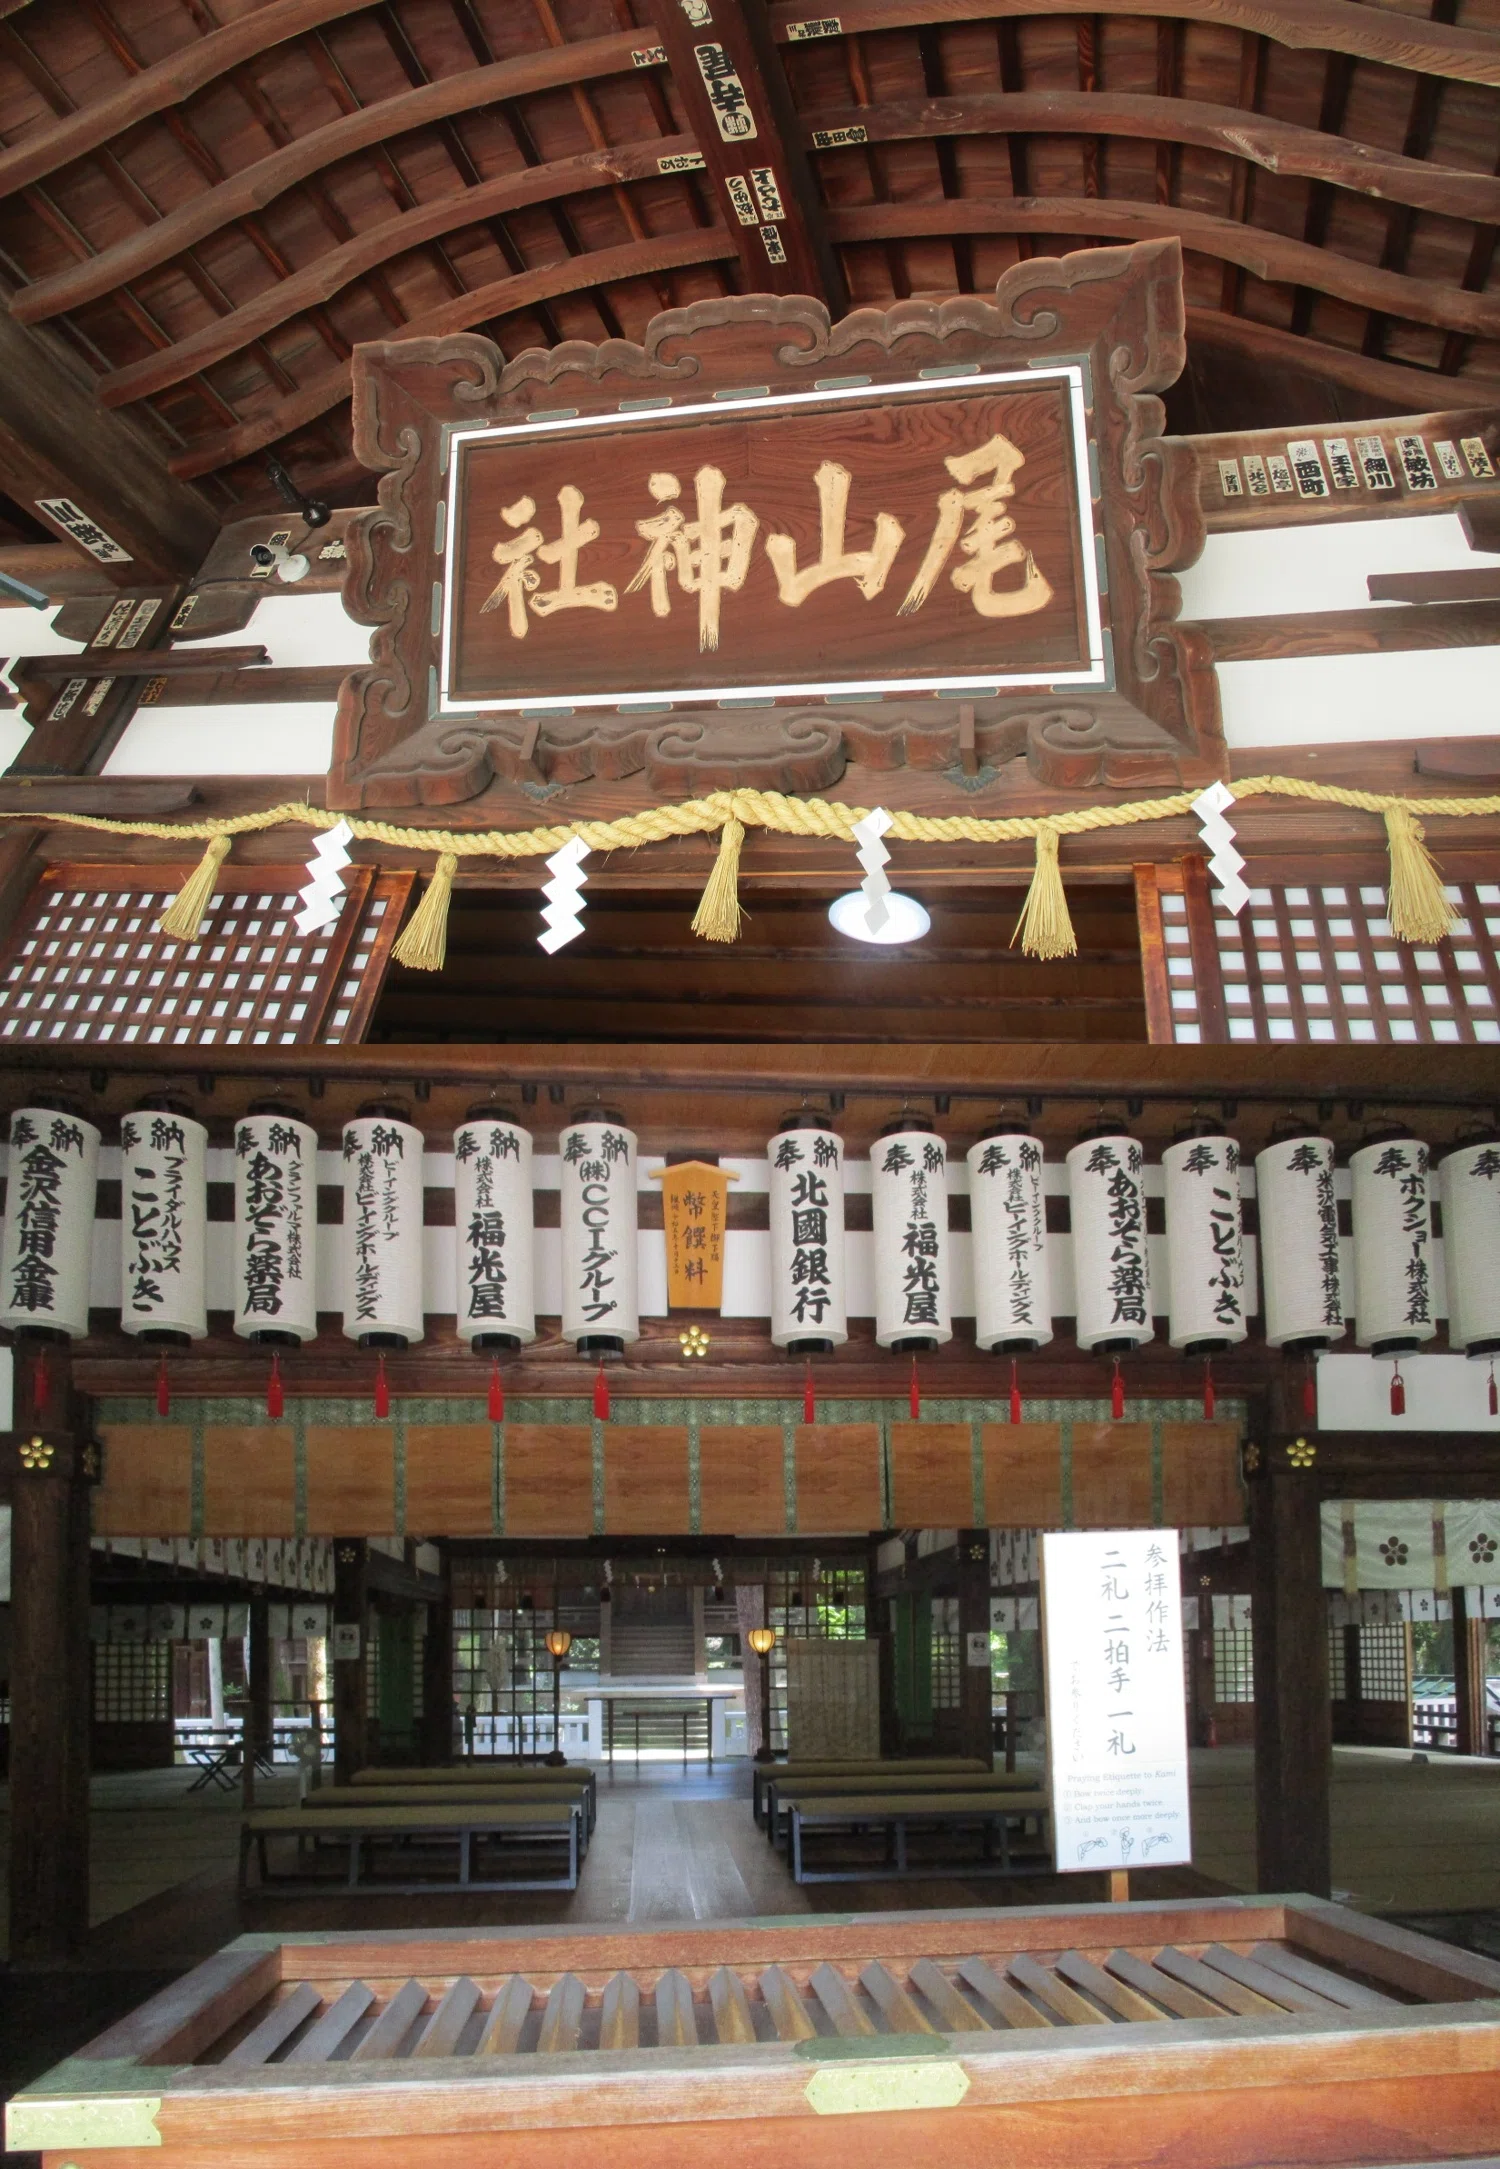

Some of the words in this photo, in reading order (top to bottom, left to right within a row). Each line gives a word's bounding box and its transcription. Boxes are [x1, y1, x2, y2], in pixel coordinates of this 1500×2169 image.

[1294, 460, 1324, 495] 西町
[1364, 458, 1393, 488] 細川
[480, 433, 1054, 653] 尾山神社
[13, 1116, 84, 1158] 奉納
[122, 1118, 185, 1155] 奉納
[236, 1123, 301, 1160] 奉納
[343, 1124, 404, 1162] 奉納
[456, 1127, 520, 1164] 奉納
[563, 1130, 629, 1166] 奉納
[774, 1135, 839, 1172] 奉納
[882, 1142, 945, 1177] 奉納
[977, 1141, 1042, 1177] 奉納
[1085, 1144, 1144, 1177] 奉納
[9, 1143, 67, 1311] 金沢信用金庫
[160, 1156, 187, 1274] ブライダルハウス
[243, 1151, 288, 1316] あおぞら薬局
[129, 1167, 164, 1312] ことぶき
[681, 1190, 708, 1285] 幣饌料
[789, 1170, 831, 1325] 北國銀行
[1107, 1167, 1147, 1326] あおぞら薬局
[1208, 1187, 1241, 1325] ことぶき
[1400, 1173, 1431, 1325] ホクショー株式会社
[1144, 1543, 1171, 1653] 参拝作法
[1067, 1775, 1100, 1783] Praying
[1102, 1772, 1141, 1782] Etiquette
[1154, 1769, 1176, 1778] Kami
[1094, 1789, 1114, 1797] twice
[1074, 1803, 1093, 1811] Clap
[1095, 1803, 1113, 1811] your
[1116, 1801, 1140, 1809] hands
[1075, 1815, 1091, 1824] And
[1094, 1814, 1109, 1823] bow
[1111, 1814, 1129, 1822] once
[1132, 1813, 1152, 1821] more
